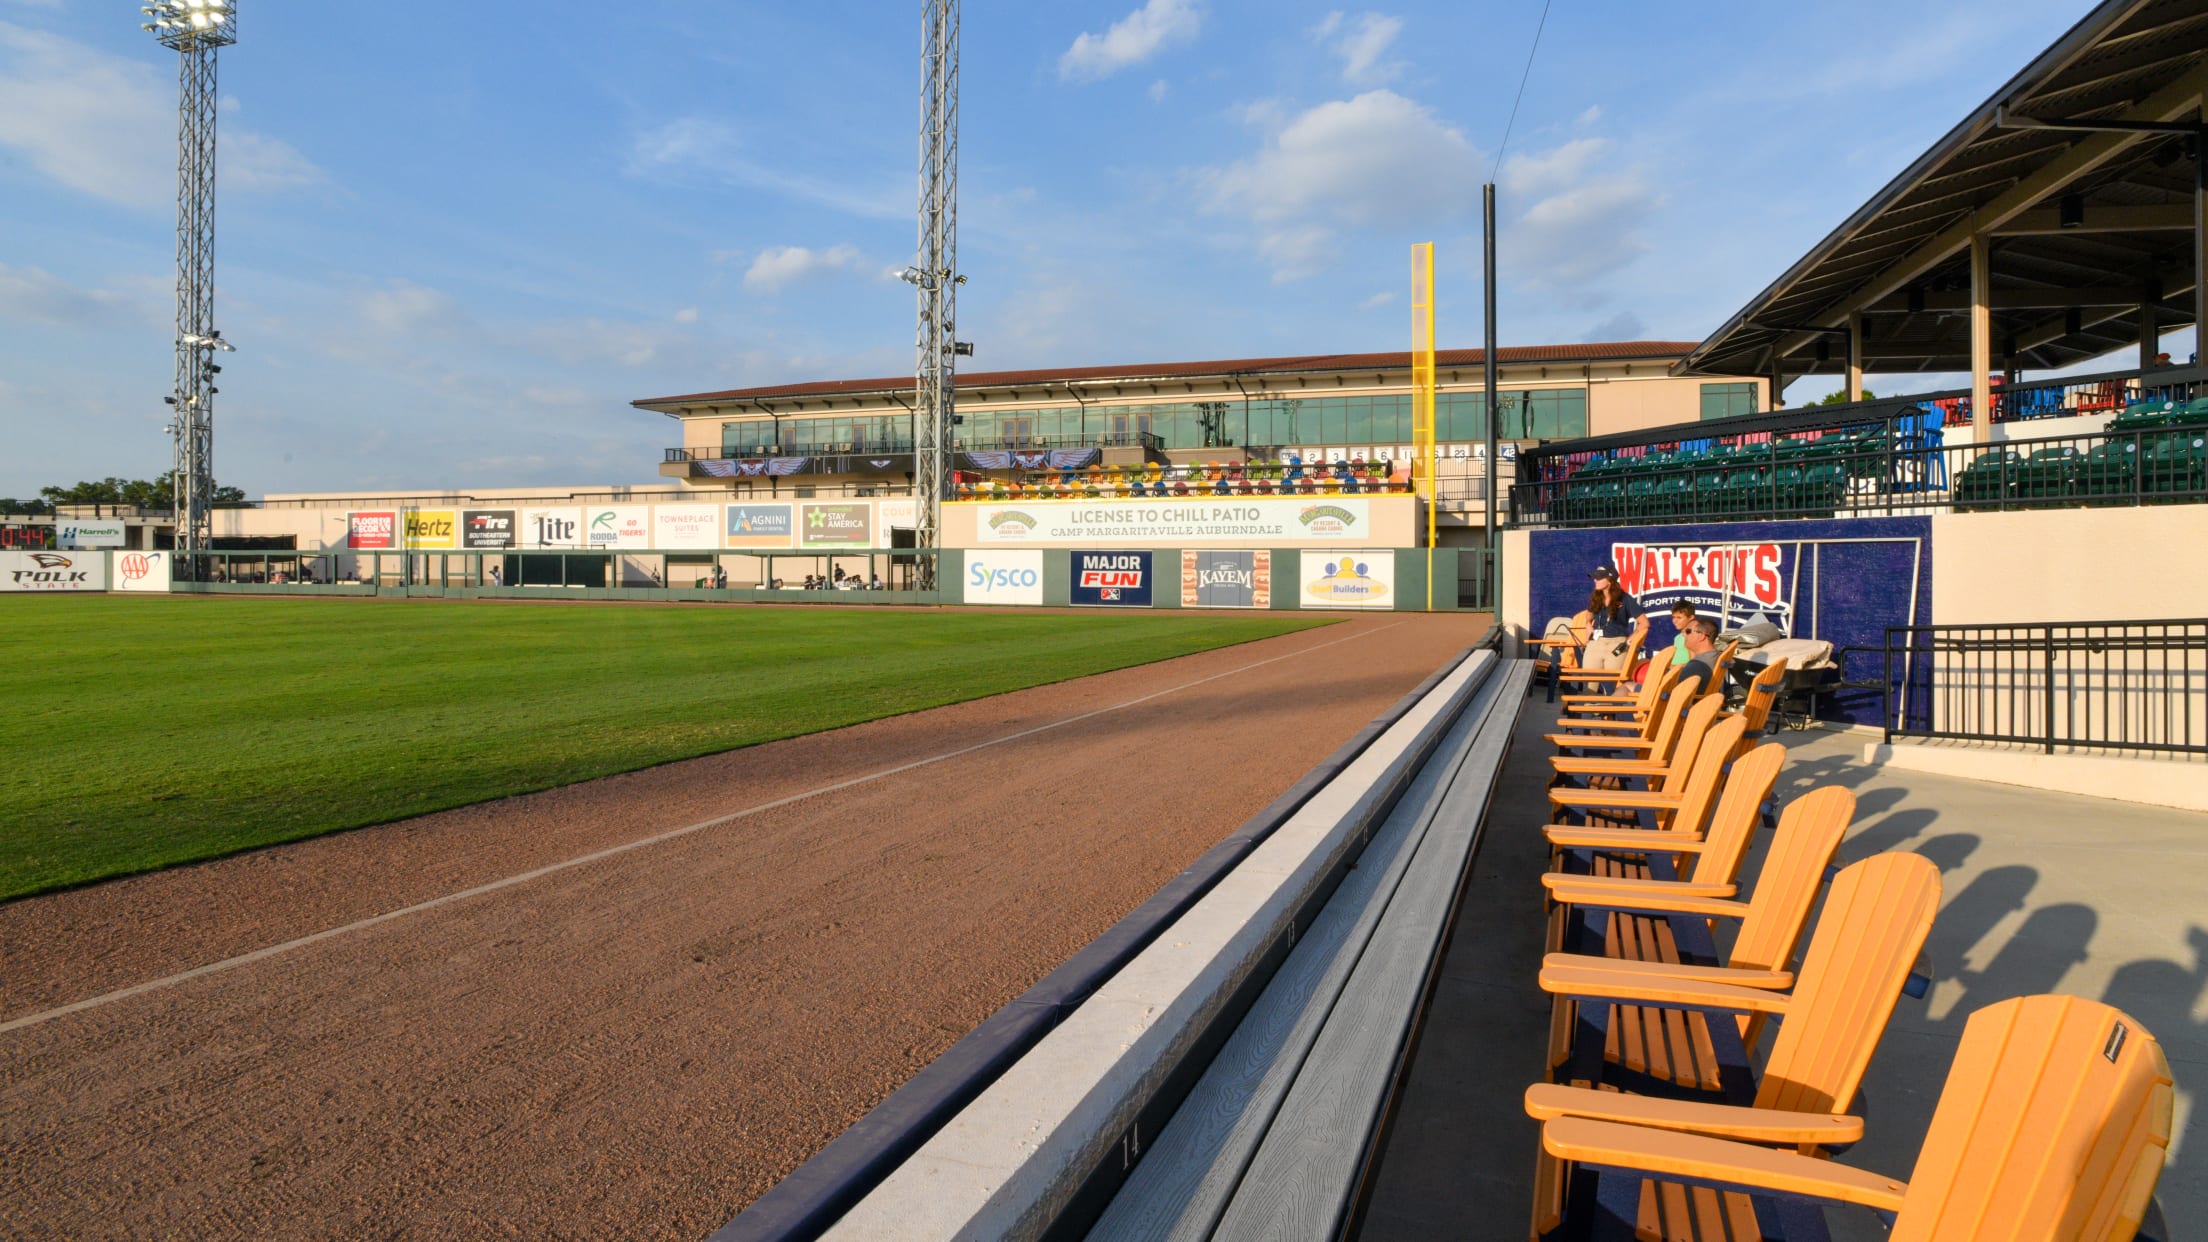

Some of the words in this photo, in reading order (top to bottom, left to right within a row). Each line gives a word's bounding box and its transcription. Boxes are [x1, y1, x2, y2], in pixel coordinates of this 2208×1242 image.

[1454, 449, 1466, 459] 23
[1503, 448, 1516, 458] 42
[352, 517, 379, 526] FLOOR
[659, 515, 714, 523] TOWNEPLACE
[751, 515, 786, 525] AGNINI
[828, 512, 847, 521] STAY
[1070, 510, 1134, 524] LICENSE
[1137, 509, 1159, 523] TO
[1162, 508, 1209, 522] CHILL
[1212, 507, 1261, 521] PATIO
[406, 518, 452, 537] Hertz
[470, 515, 509, 529] Fire
[828, 520, 864, 528] AMERICA
[537, 516, 575, 546] Lite
[590, 532, 618, 541] RODDA
[619, 529, 646, 537] TIGERS!
[1050, 528, 1084, 537] CAMP
[1086, 526, 1193, 537] MARGARITAVILLE
[1196, 525, 1284, 536] AUBURNDALE
[123, 555, 147, 579] AAA
[1083, 556, 1141, 570] MAJOR
[11, 570, 88, 583] POLK
[970, 561, 1038, 592] Sysco
[1083, 572, 1139, 586] FUN
[1198, 569, 1252, 589] KAYEM
[1332, 584, 1369, 593] Builders
